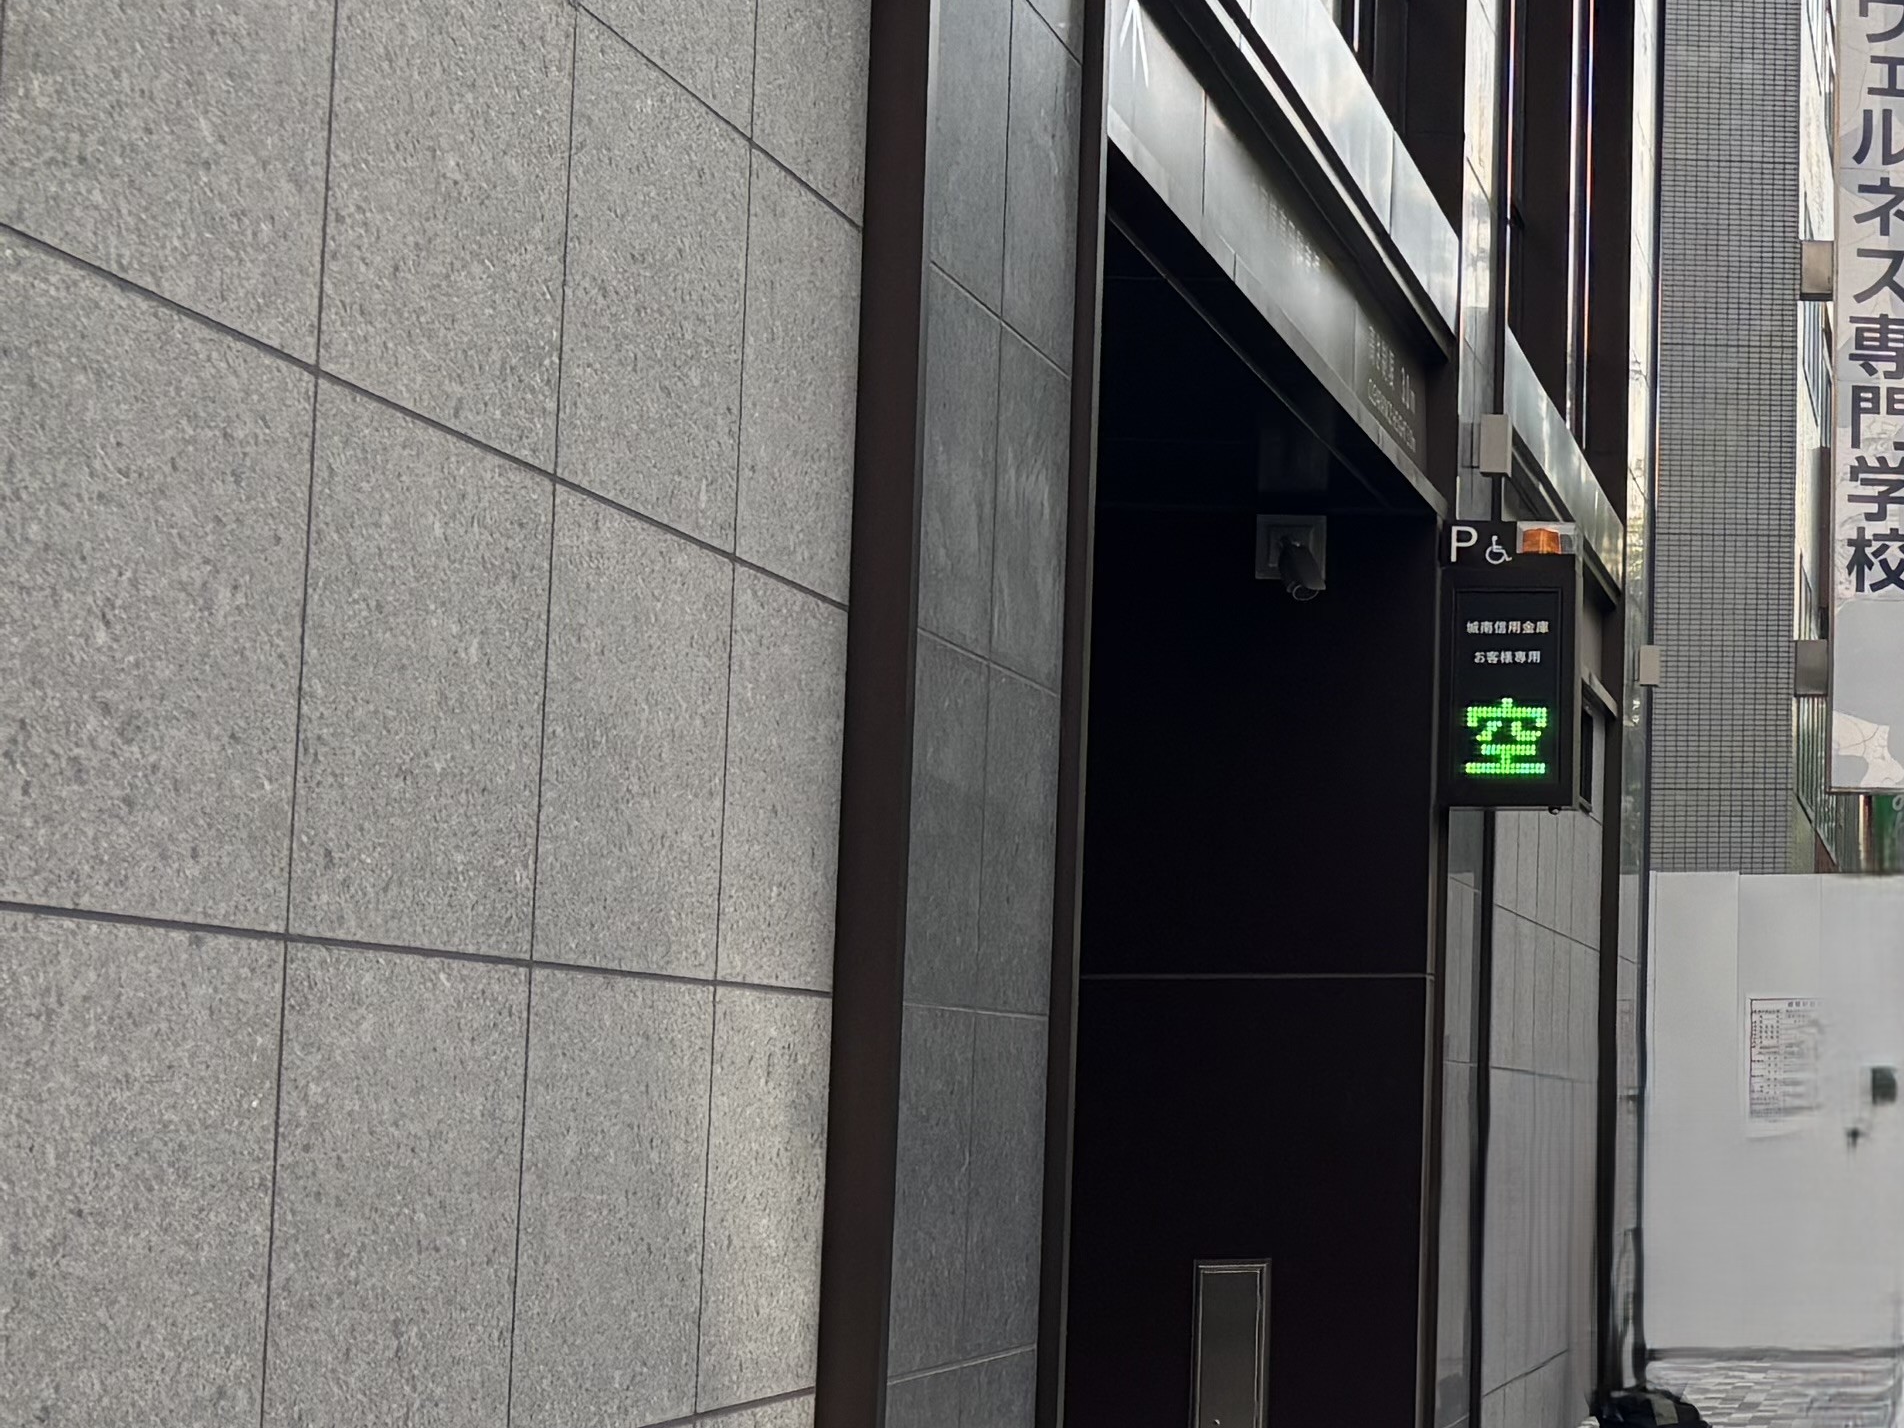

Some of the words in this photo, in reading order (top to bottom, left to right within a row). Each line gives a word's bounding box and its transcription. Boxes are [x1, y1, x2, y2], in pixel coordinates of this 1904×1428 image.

[1450, 525, 1479, 563] P
[1466, 620, 1550, 635] 城南信用金庫
[1473, 650, 1542, 665] お客様専用
[1463, 697, 1548, 776] 空
